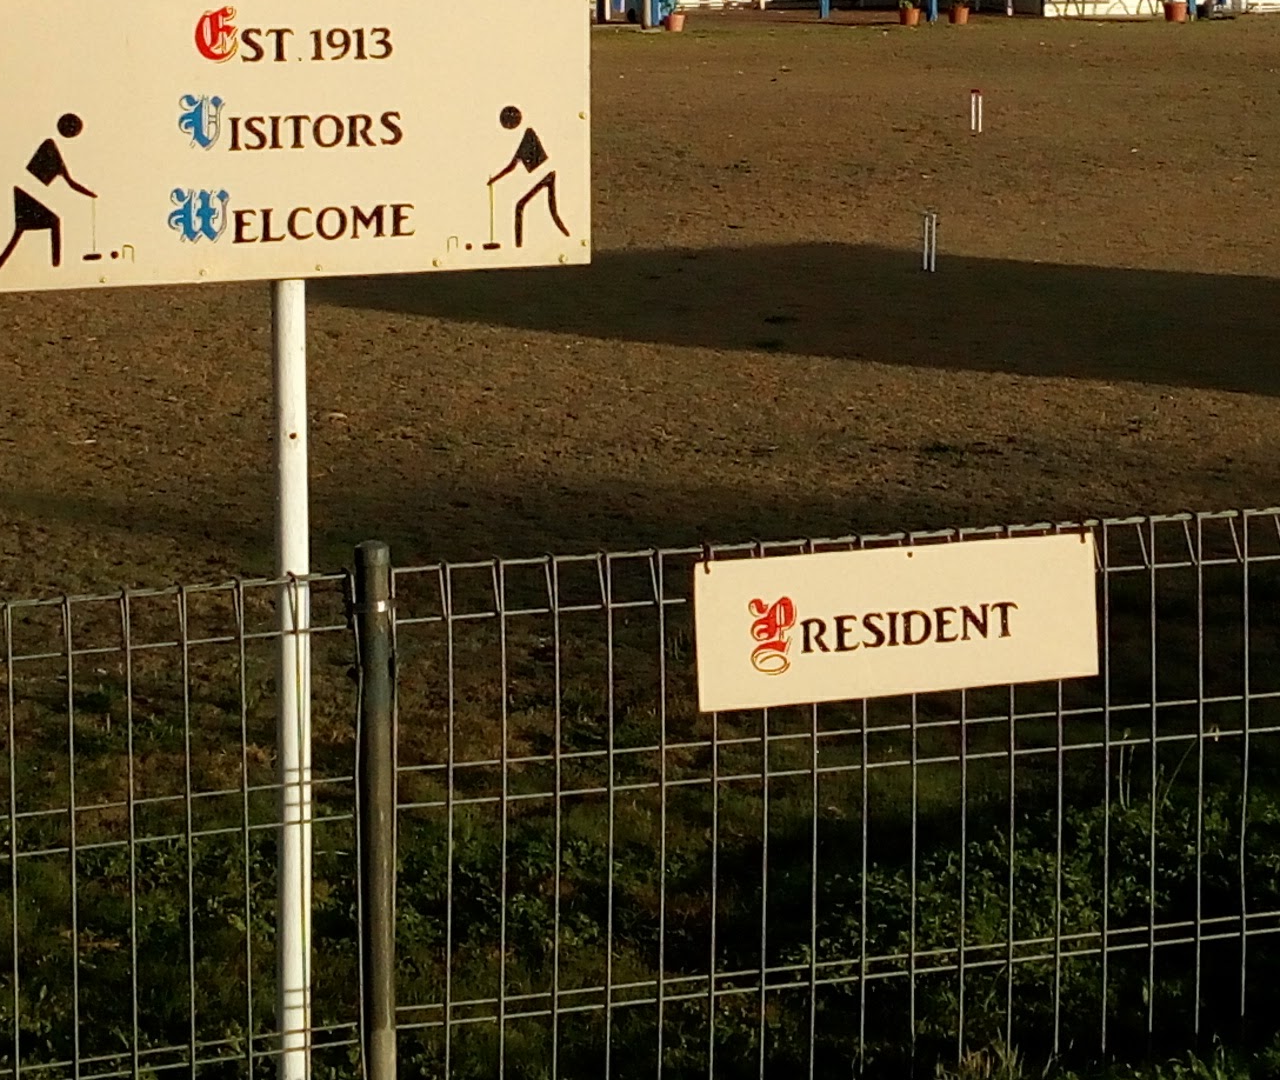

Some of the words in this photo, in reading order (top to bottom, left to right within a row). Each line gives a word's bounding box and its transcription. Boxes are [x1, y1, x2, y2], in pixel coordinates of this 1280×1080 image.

[178, 94, 402, 151] VISITORS
[167, 188, 415, 244] WELCOME
[748, 596, 1018, 676] PRESIDENT
